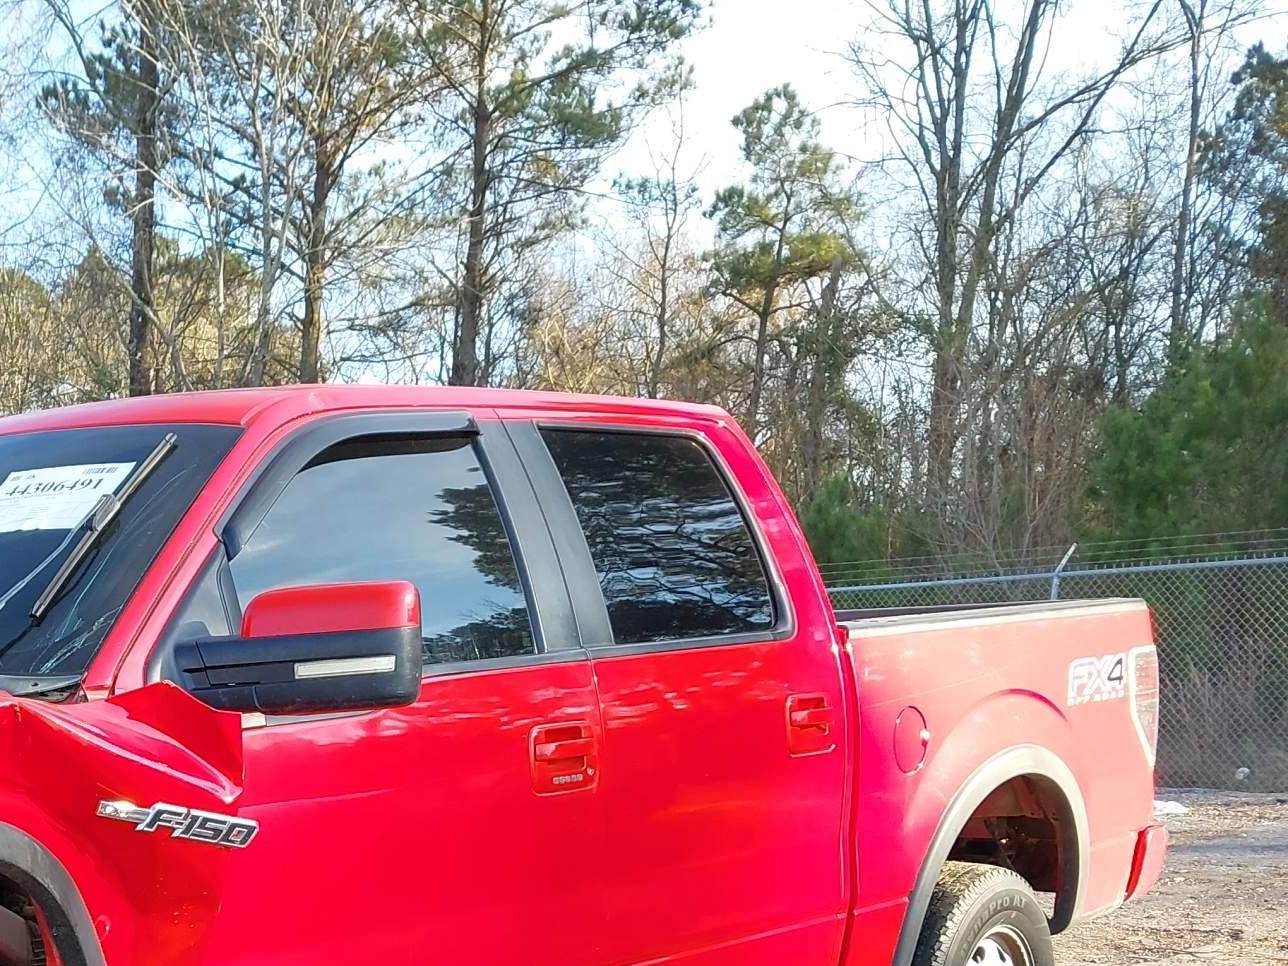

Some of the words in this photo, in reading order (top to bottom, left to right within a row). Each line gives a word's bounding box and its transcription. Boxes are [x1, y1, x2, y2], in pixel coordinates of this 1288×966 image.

[4, 477, 105, 497] 44306491
[1068, 652, 1127, 696] FX4
[136, 801, 259, 849] F-150
